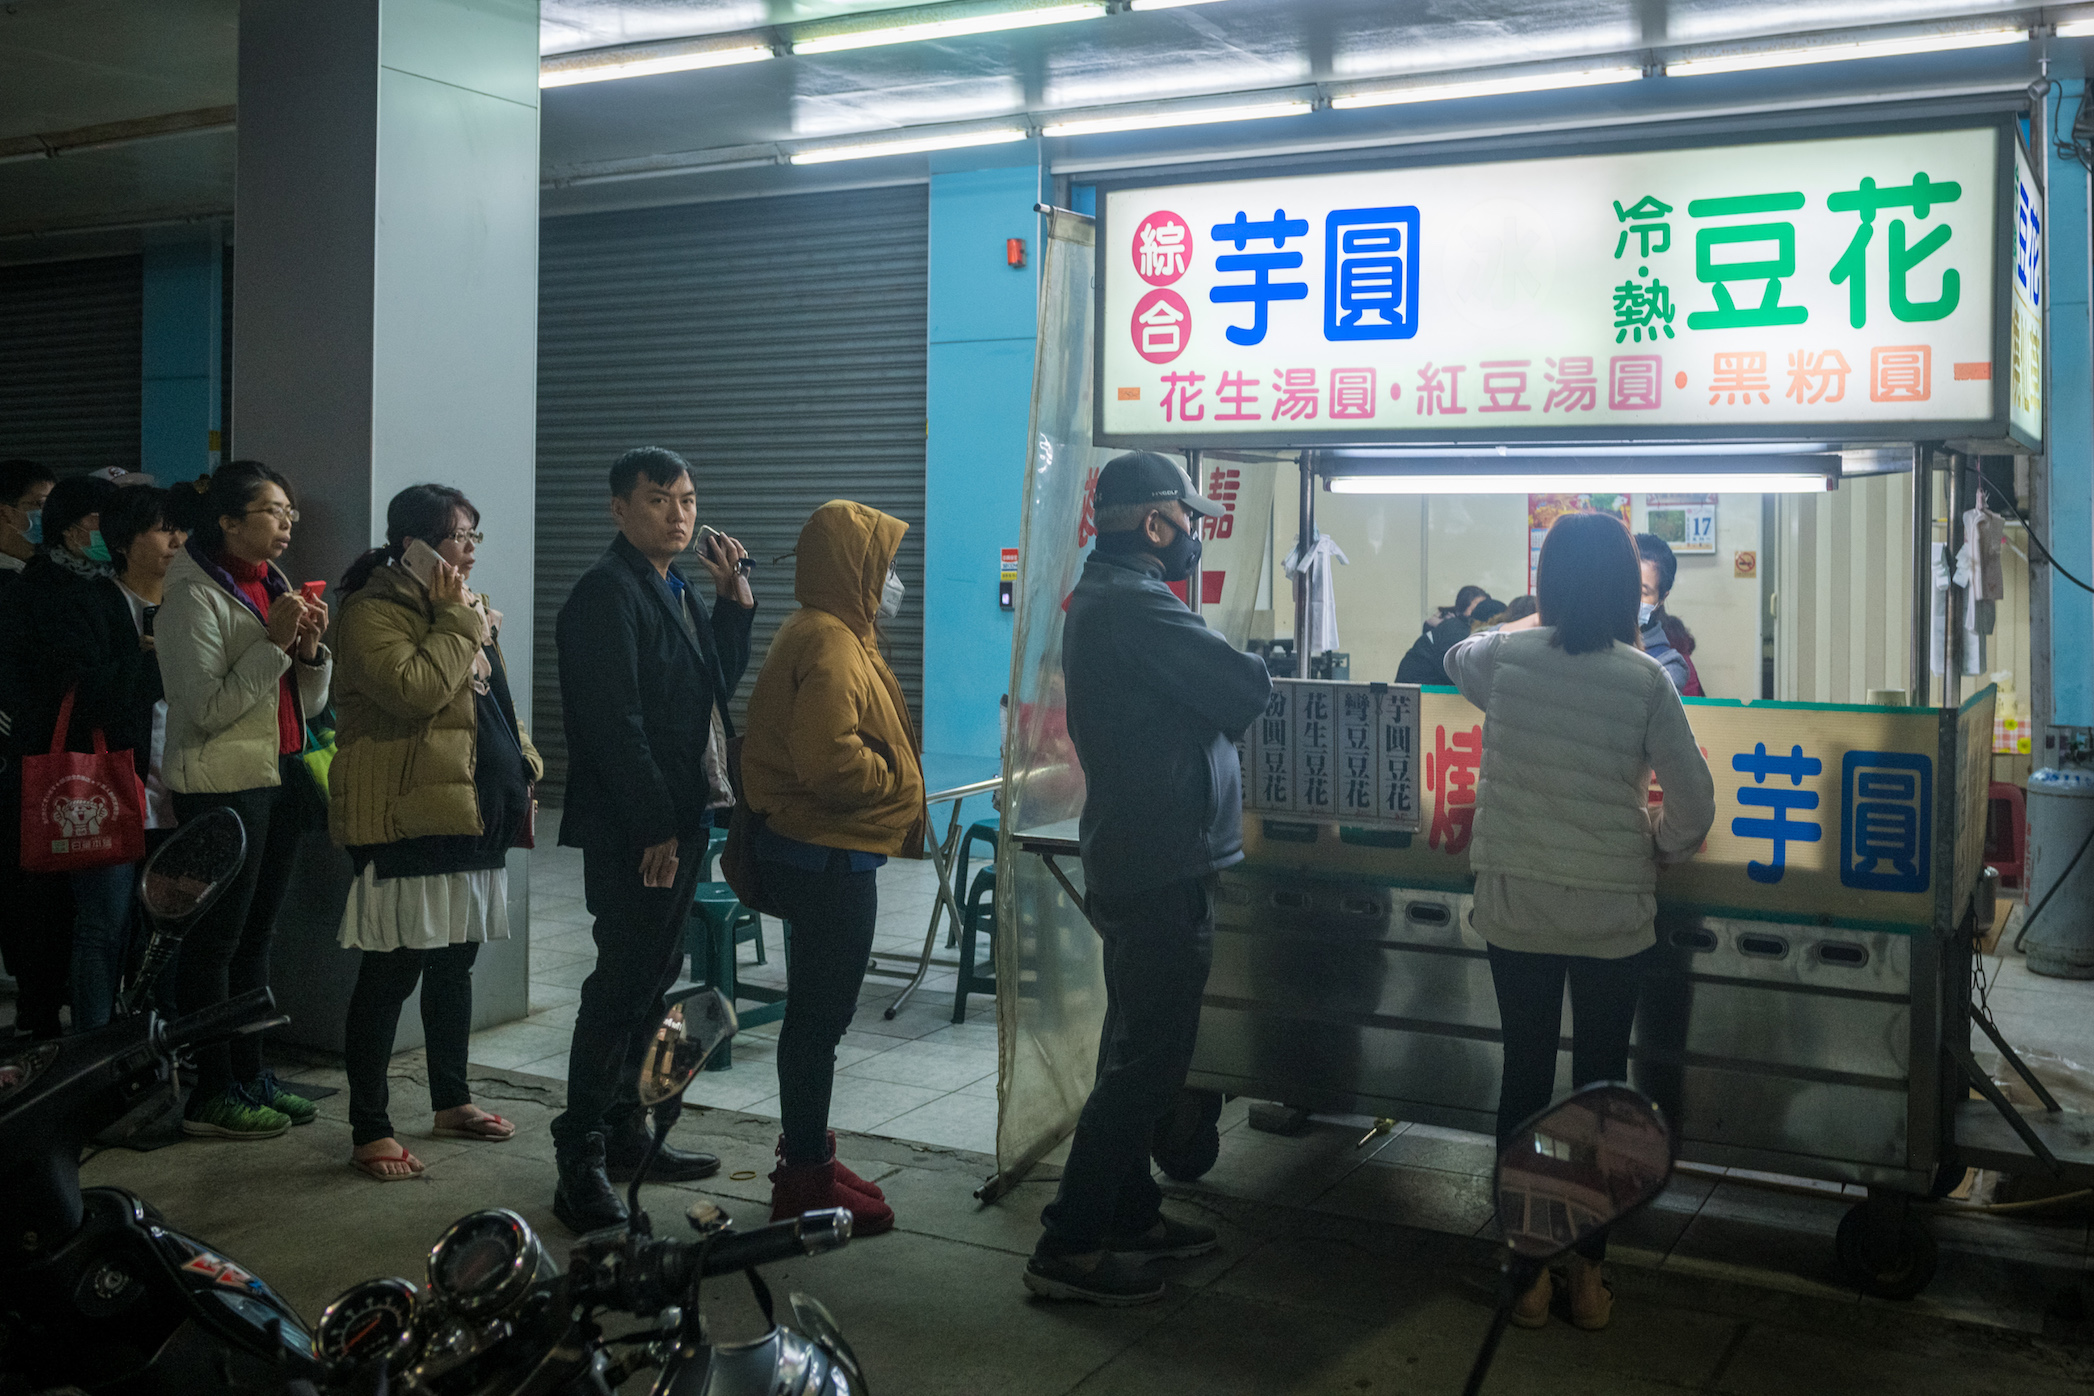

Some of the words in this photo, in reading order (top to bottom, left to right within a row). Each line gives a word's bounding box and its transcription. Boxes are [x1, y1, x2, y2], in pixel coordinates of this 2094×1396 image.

[1139, 221, 1186, 354] 綜合
[1209, 205, 1421, 346] 芋圓
[1686, 171, 1963, 330] 豆花
[1693, 517, 1712, 536] 17
[1302, 692, 1329, 806] 花生豆花
[1385, 695, 1411, 812] 芋圓豆花
[1731, 741, 1933, 894] 芋圓
